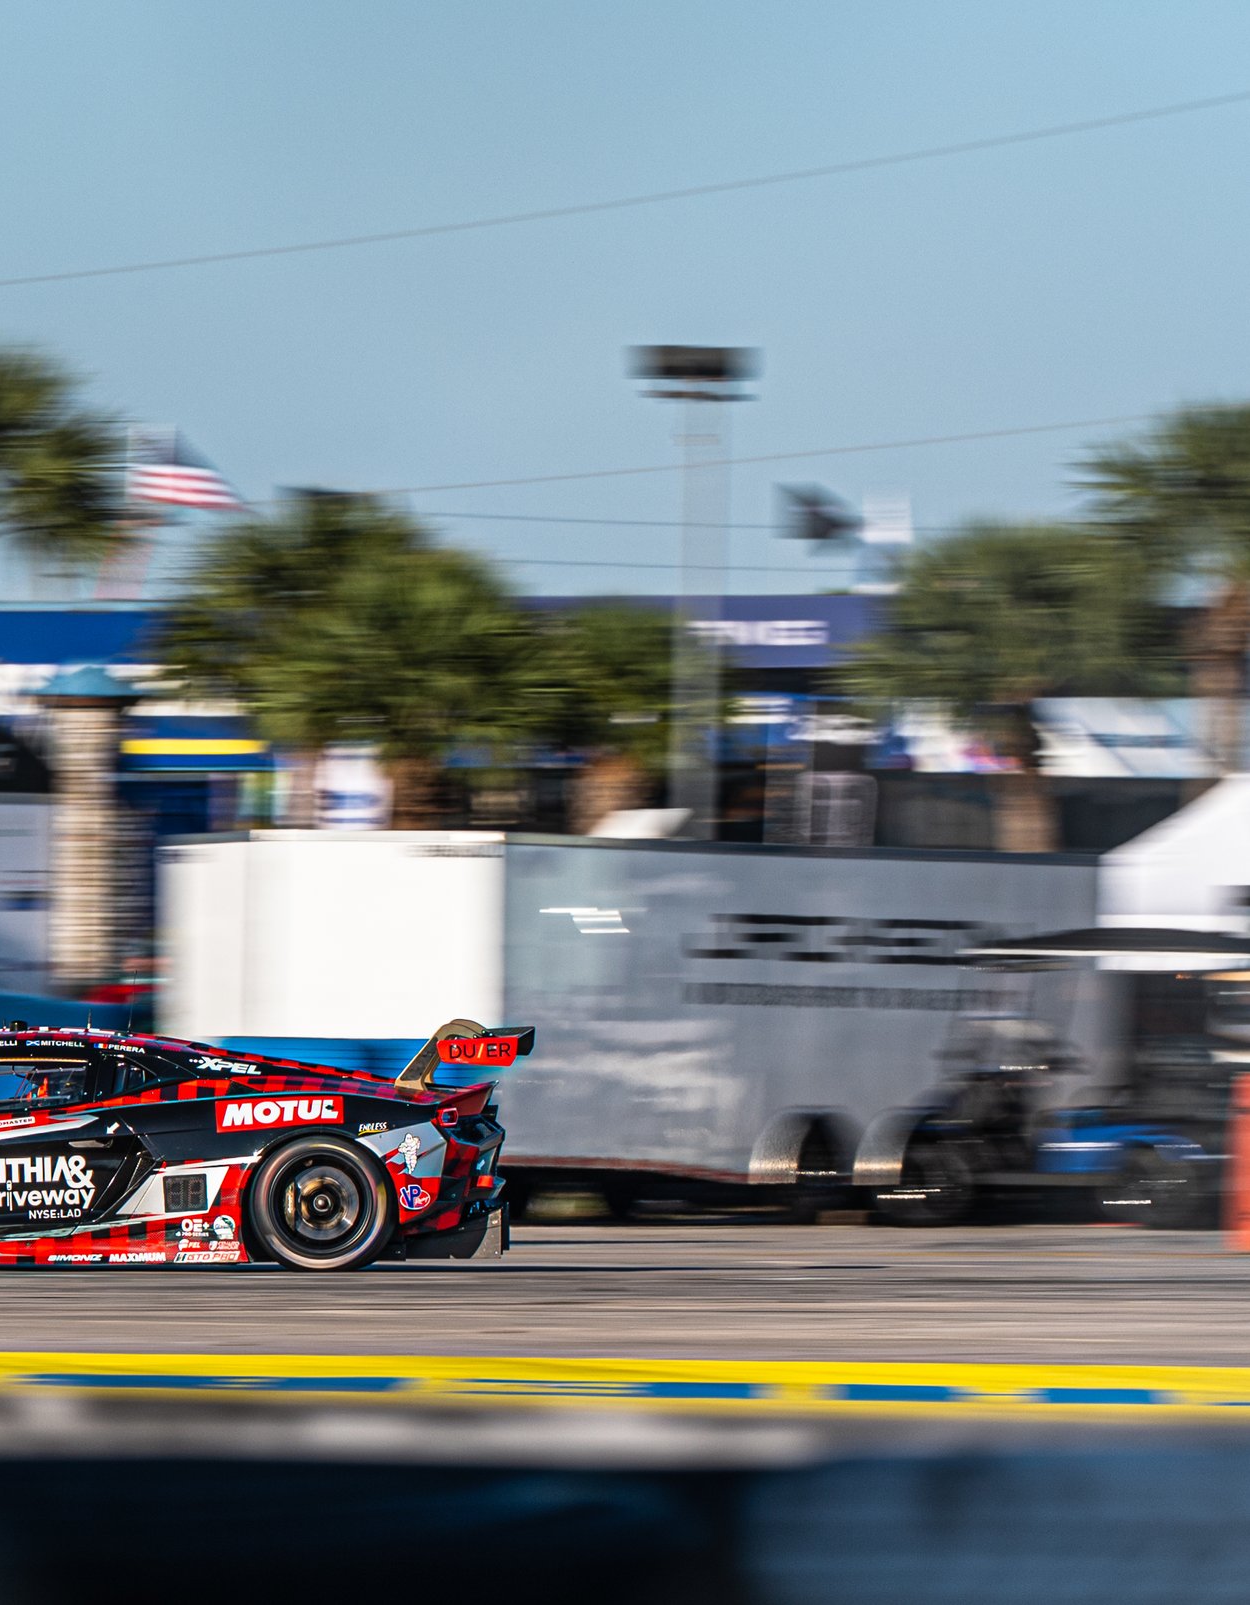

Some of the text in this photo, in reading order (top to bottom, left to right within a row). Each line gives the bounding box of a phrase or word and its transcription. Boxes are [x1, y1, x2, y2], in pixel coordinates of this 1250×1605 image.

[40, 1040, 85, 1048] MITCHELL
[108, 1043, 146, 1054] PERERA
[197, 1056, 262, 1076] XPEL
[222, 1099, 339, 1127] MOTUL
[358, 1121, 388, 1132] ENDLESS
[400, 1185, 422, 1209] VP
[28, 1208, 82, 1220] NYSE:LAD
[109, 1252, 167, 1262] MAXIMUM
